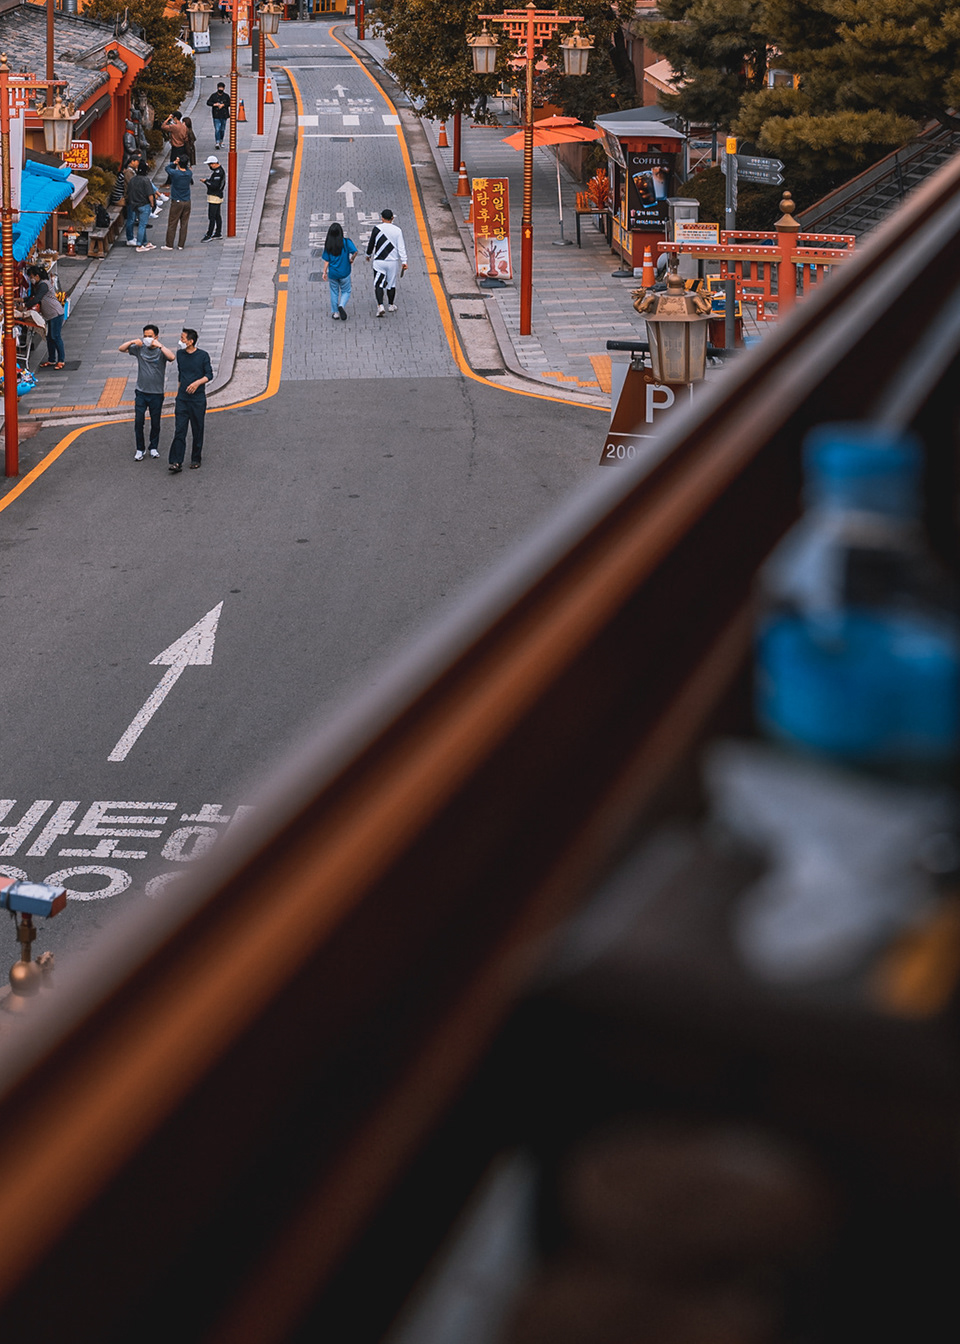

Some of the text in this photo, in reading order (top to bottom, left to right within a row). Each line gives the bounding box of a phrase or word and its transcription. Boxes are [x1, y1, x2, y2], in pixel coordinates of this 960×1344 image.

[632, 156, 662, 165] COFFEE
[476, 191, 491, 241] 탕후루
[491, 181, 507, 241] 과일사탕
[645, 383, 675, 423] P
